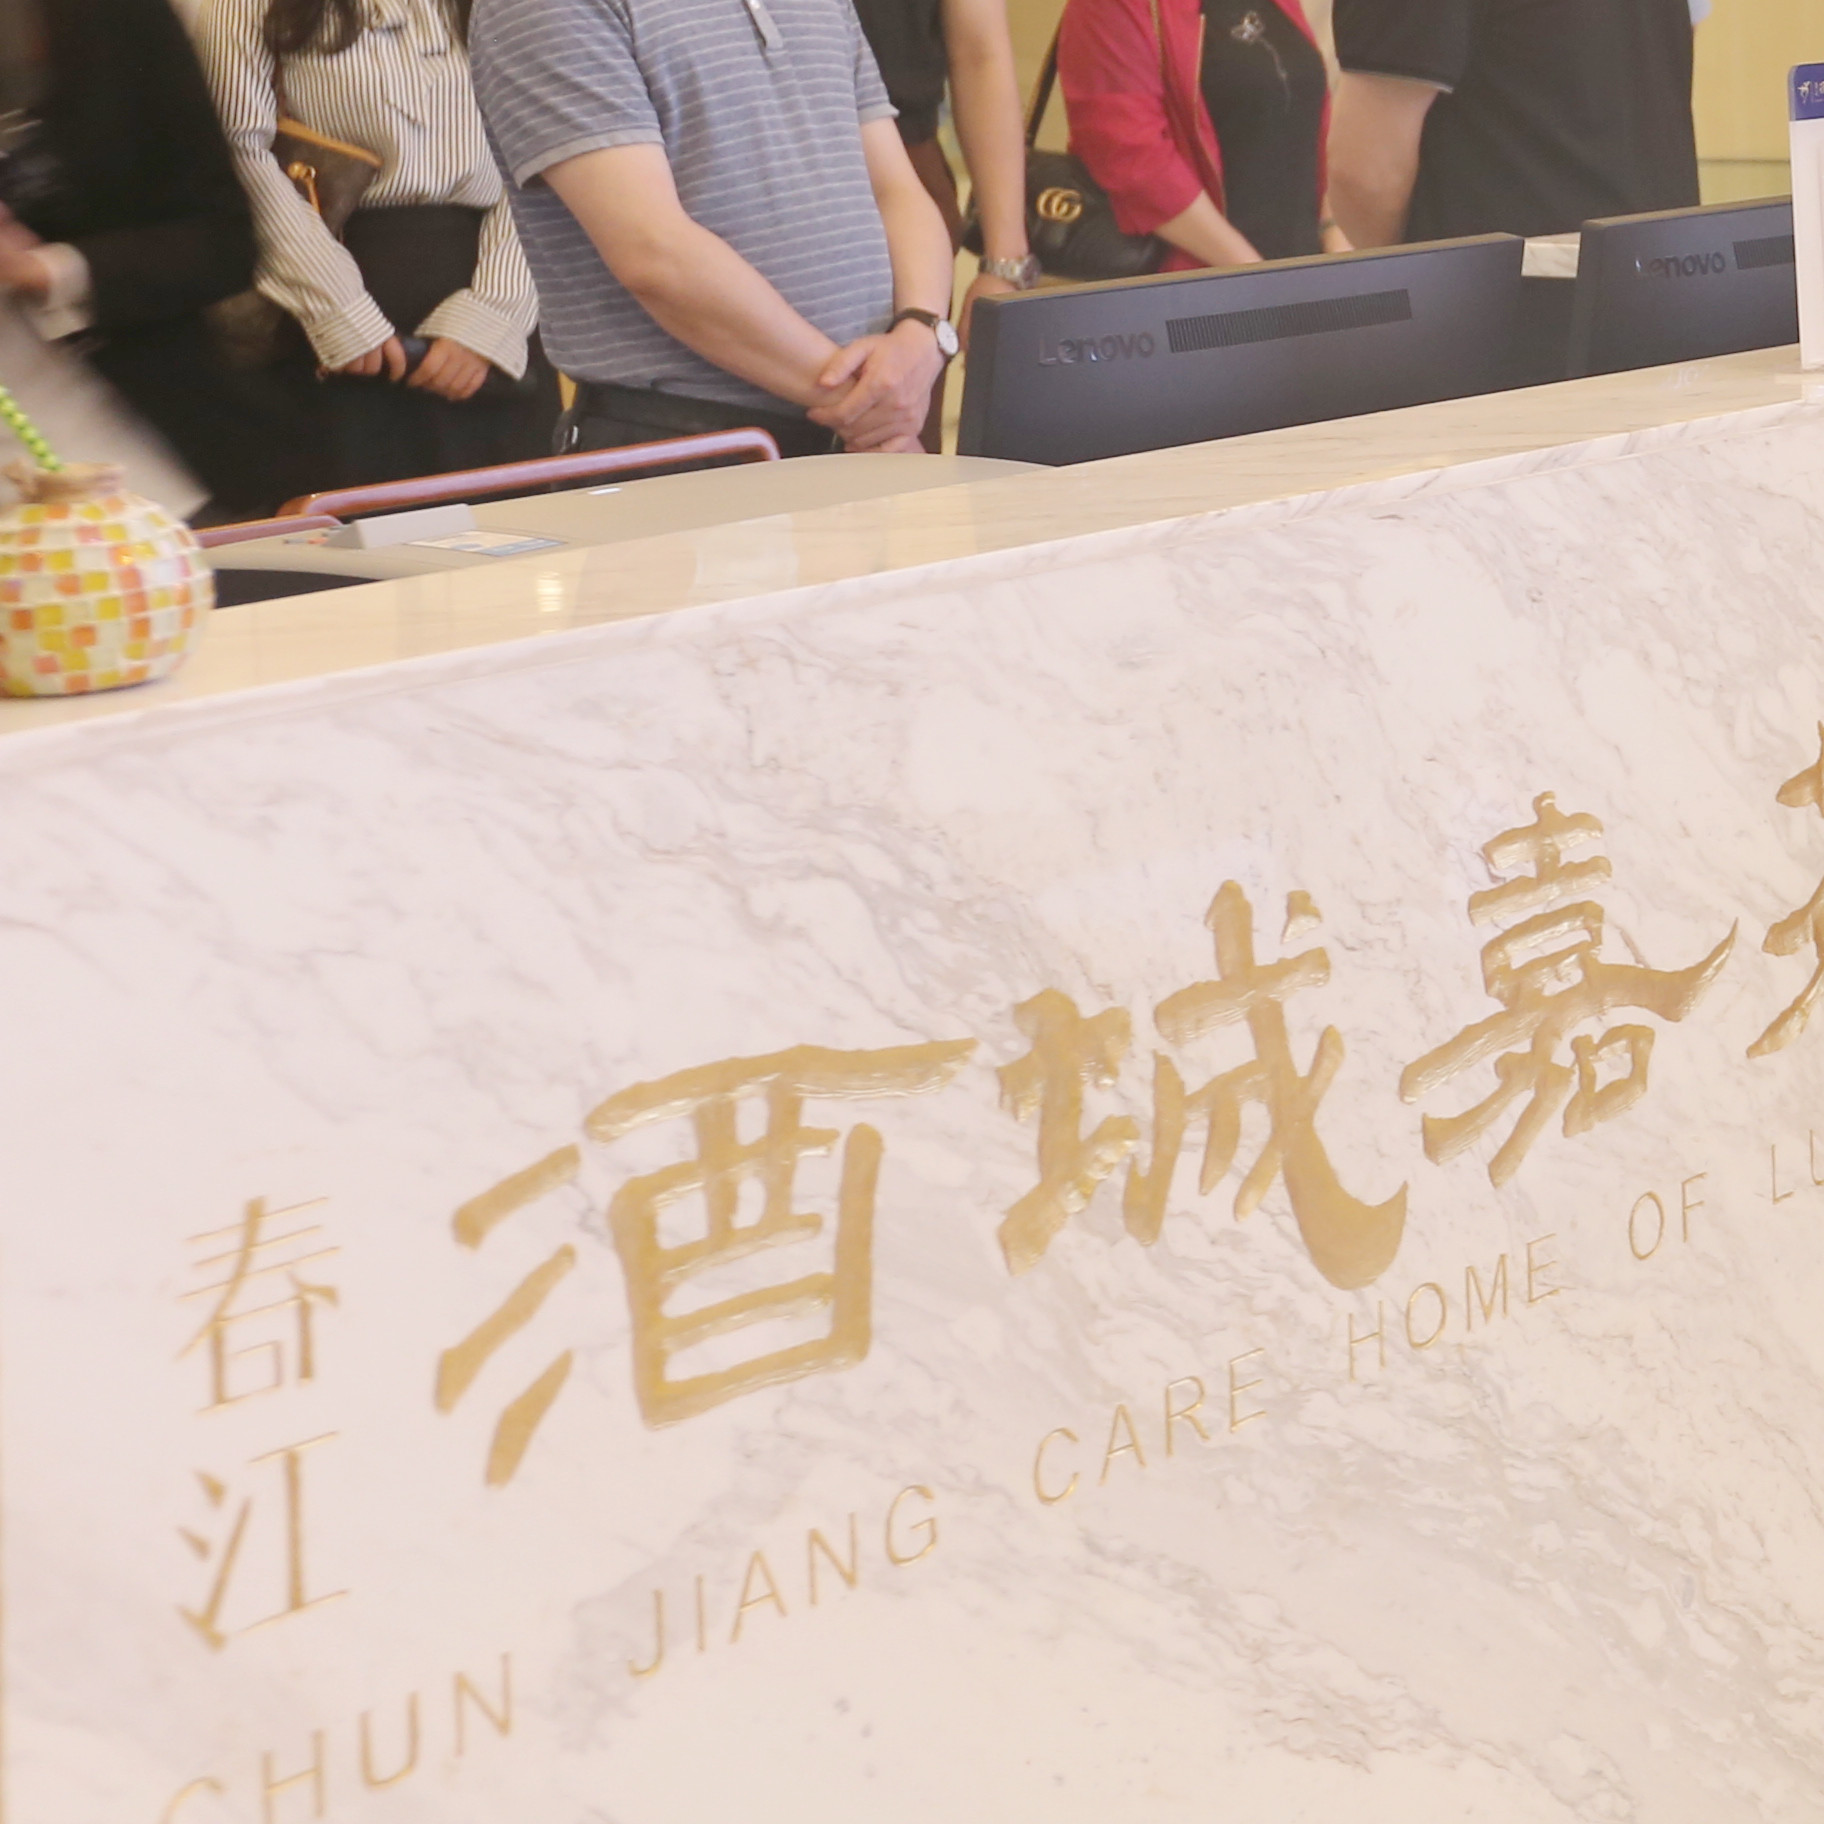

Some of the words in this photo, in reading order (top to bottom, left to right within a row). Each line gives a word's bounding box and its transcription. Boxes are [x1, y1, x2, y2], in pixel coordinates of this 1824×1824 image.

[1038, 331, 1155, 366] Lenovo
[174, 1194, 350, 1652] 春江
[627, 1484, 941, 1679] JIANG
[1032, 1348, 1268, 1506] CARE
[1346, 1234, 1561, 1379] HOME
[1627, 1172, 1710, 1261] OF
